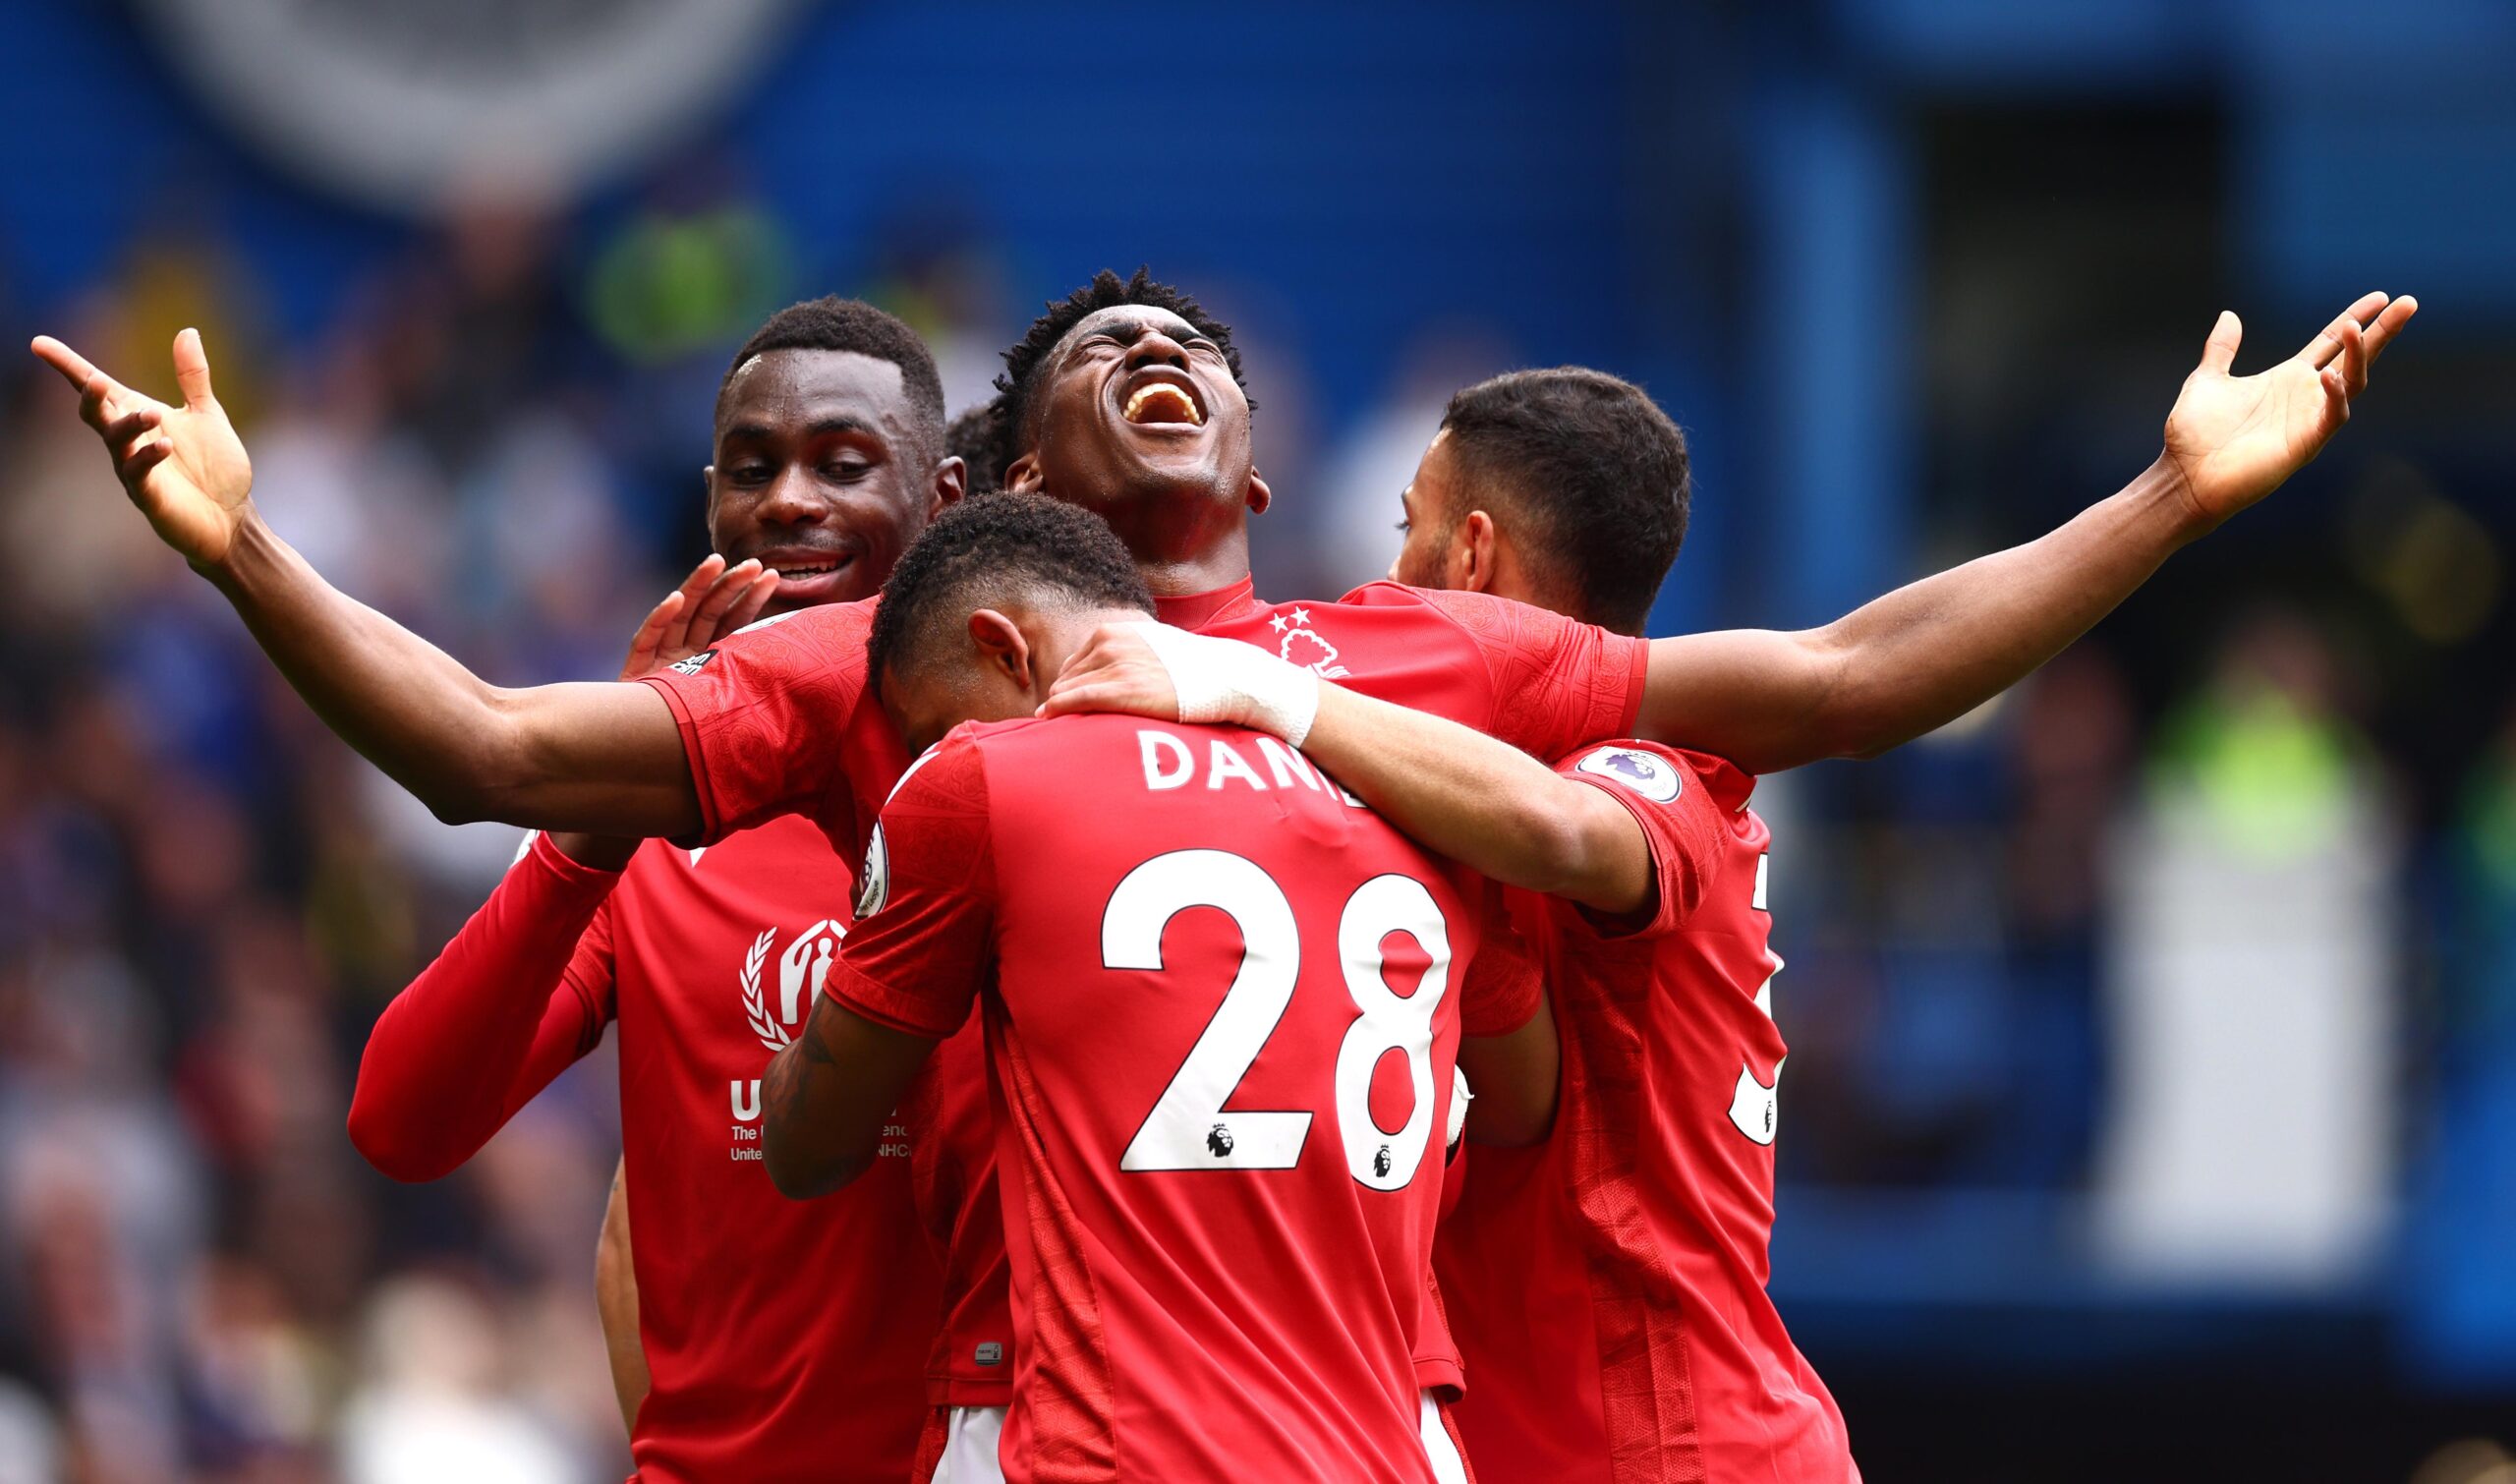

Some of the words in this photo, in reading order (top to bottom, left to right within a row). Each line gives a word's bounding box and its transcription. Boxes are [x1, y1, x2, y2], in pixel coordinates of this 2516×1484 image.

[1101, 848, 1452, 1192] 28
[731, 1125, 757, 1140] The
[730, 1147, 763, 1161] Unite
[878, 1143, 912, 1157] NHC
